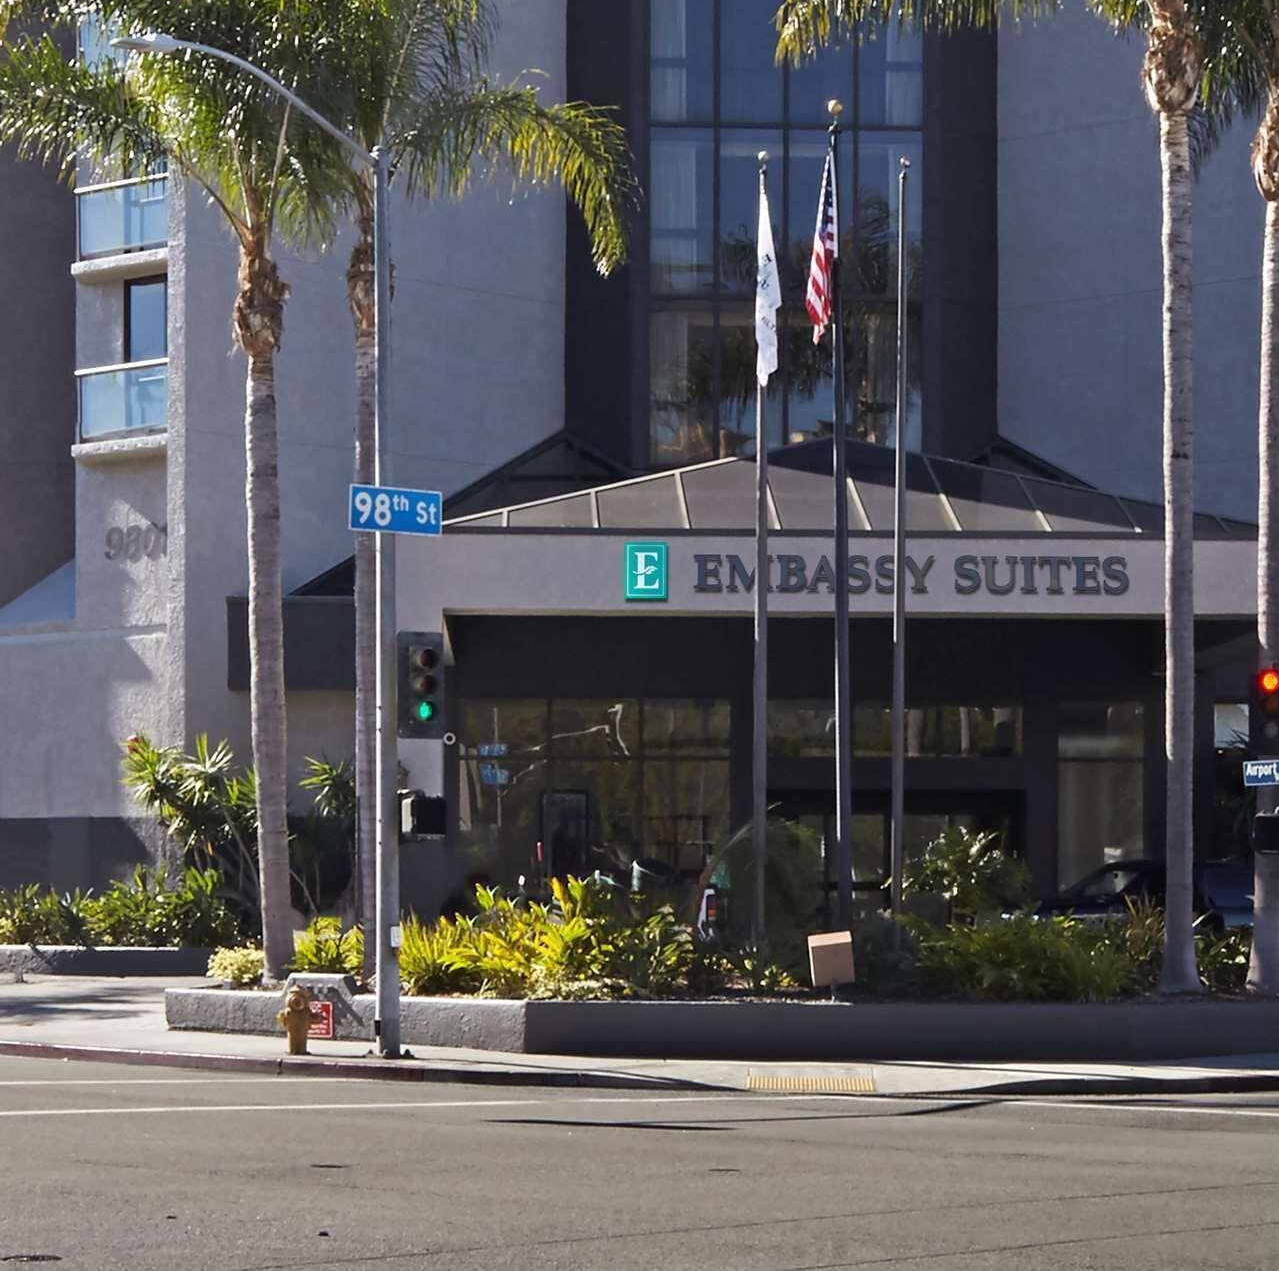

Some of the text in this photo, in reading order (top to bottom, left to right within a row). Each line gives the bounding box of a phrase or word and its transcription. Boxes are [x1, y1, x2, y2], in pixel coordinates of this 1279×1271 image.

[354, 491, 438, 527] 98th St
[632, 551, 660, 590] E
[693, 554, 1131, 596] EMBASSY SUITES
[1246, 762, 1278, 779] Airport
